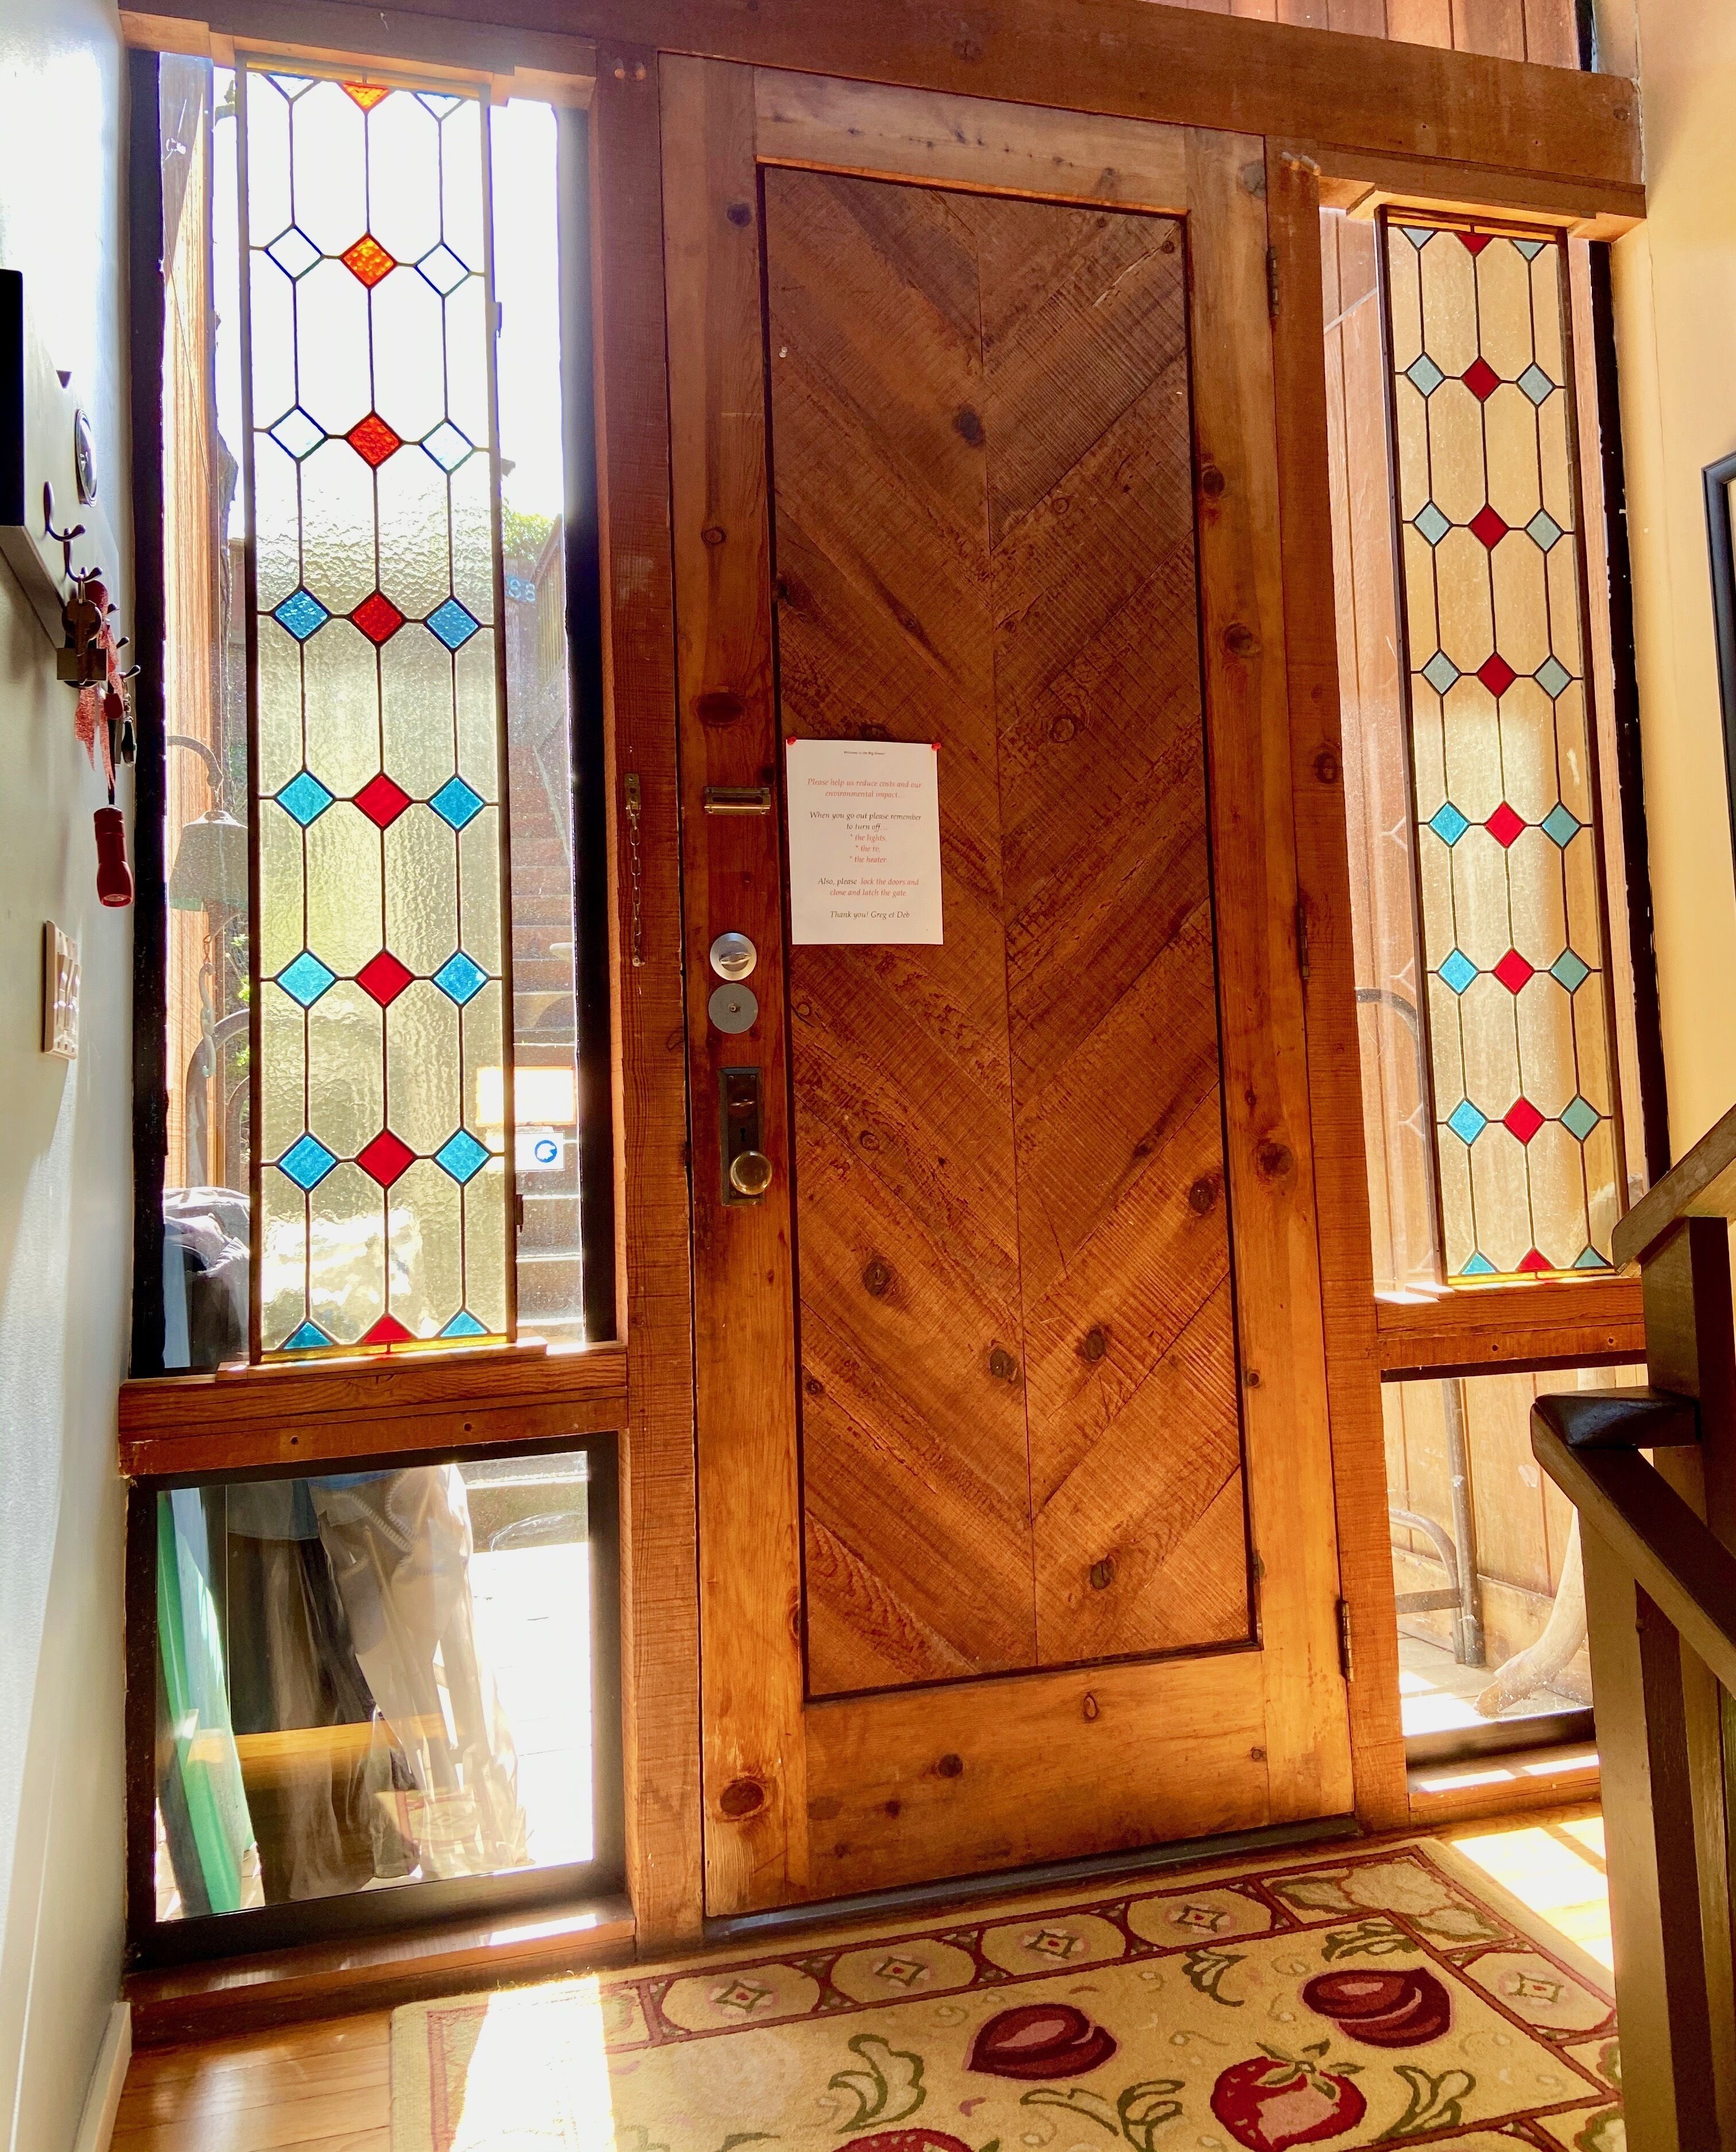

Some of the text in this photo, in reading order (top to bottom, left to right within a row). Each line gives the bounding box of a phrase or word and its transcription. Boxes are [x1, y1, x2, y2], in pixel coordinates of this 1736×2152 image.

[807, 778, 828, 786] Please
[830, 779, 844, 788] help
[869, 812, 889, 821] please
[836, 878, 858, 887] please
[853, 911, 869, 920] you!
[870, 911, 887, 920] Greg
